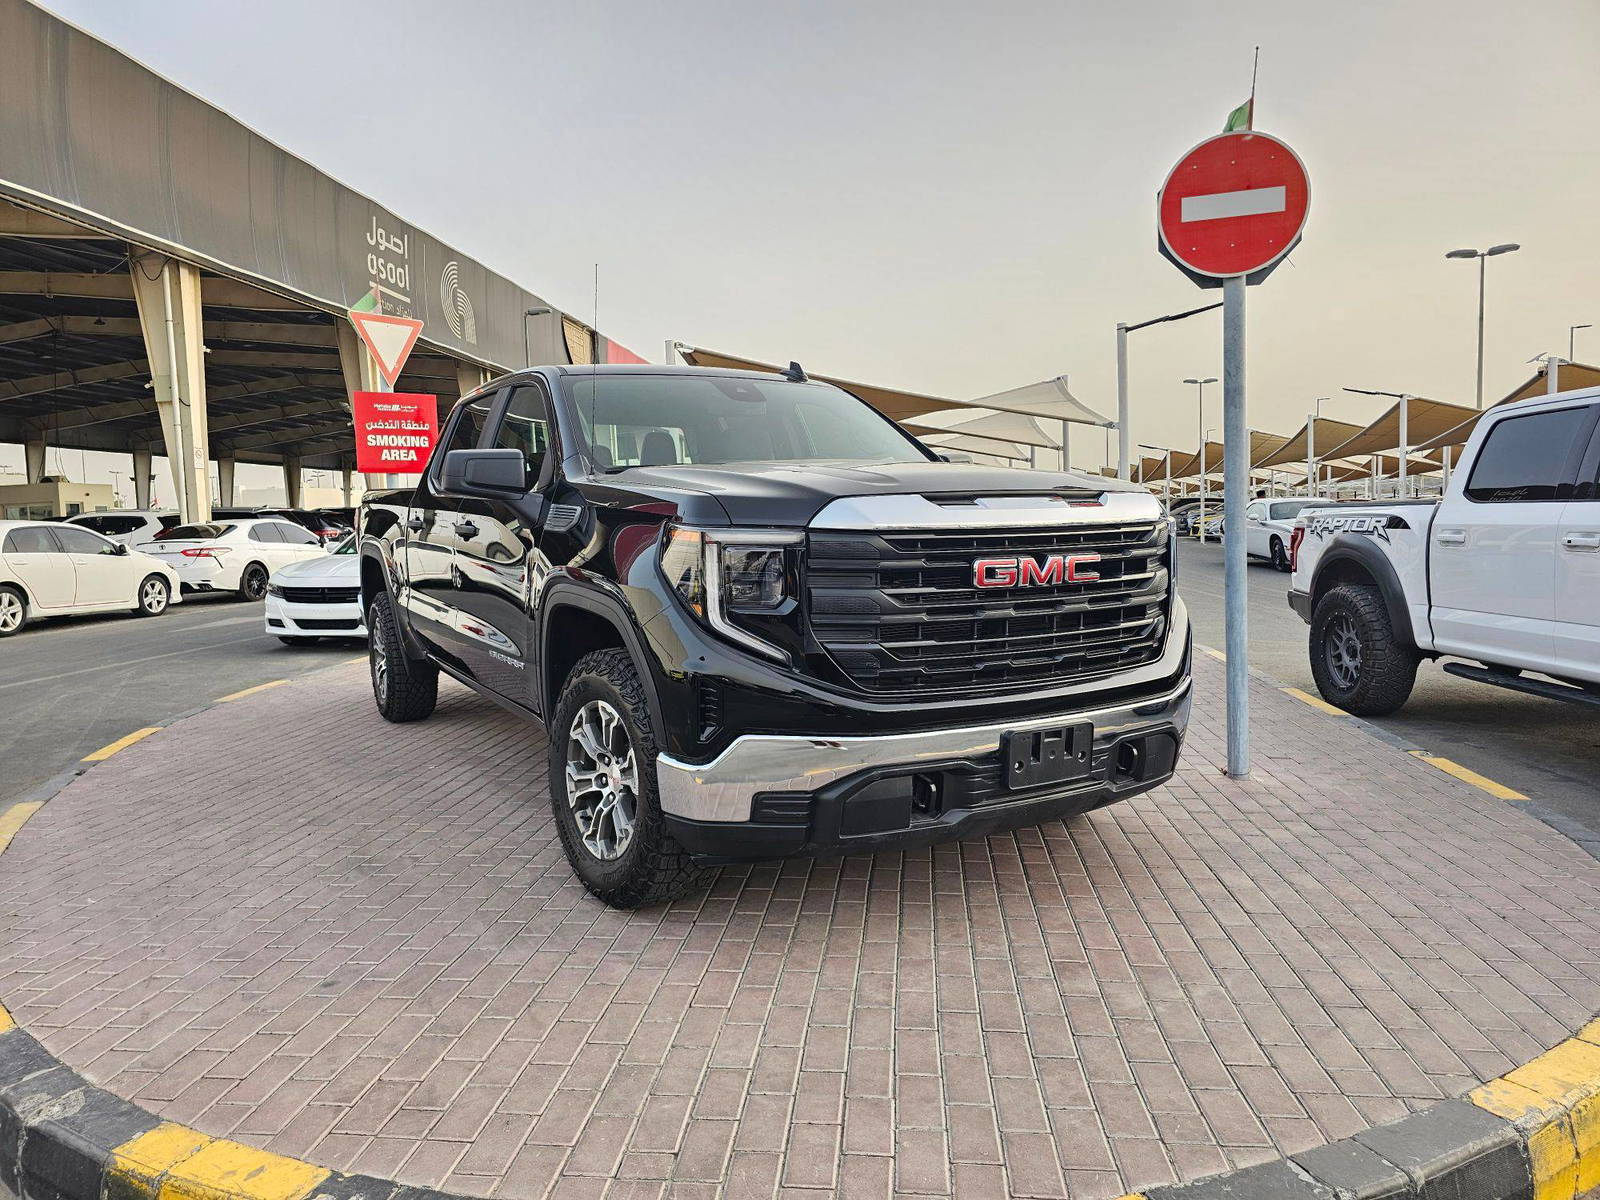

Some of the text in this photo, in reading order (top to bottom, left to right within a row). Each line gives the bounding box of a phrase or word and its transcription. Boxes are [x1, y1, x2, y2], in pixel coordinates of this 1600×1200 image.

[365, 419, 430, 430] منطقة التدخين
[367, 434, 429, 447] SMOKING
[381, 449, 417, 461] AREA
[1310, 516, 1391, 546] RAPTOR
[973, 554, 1101, 588] GMC
